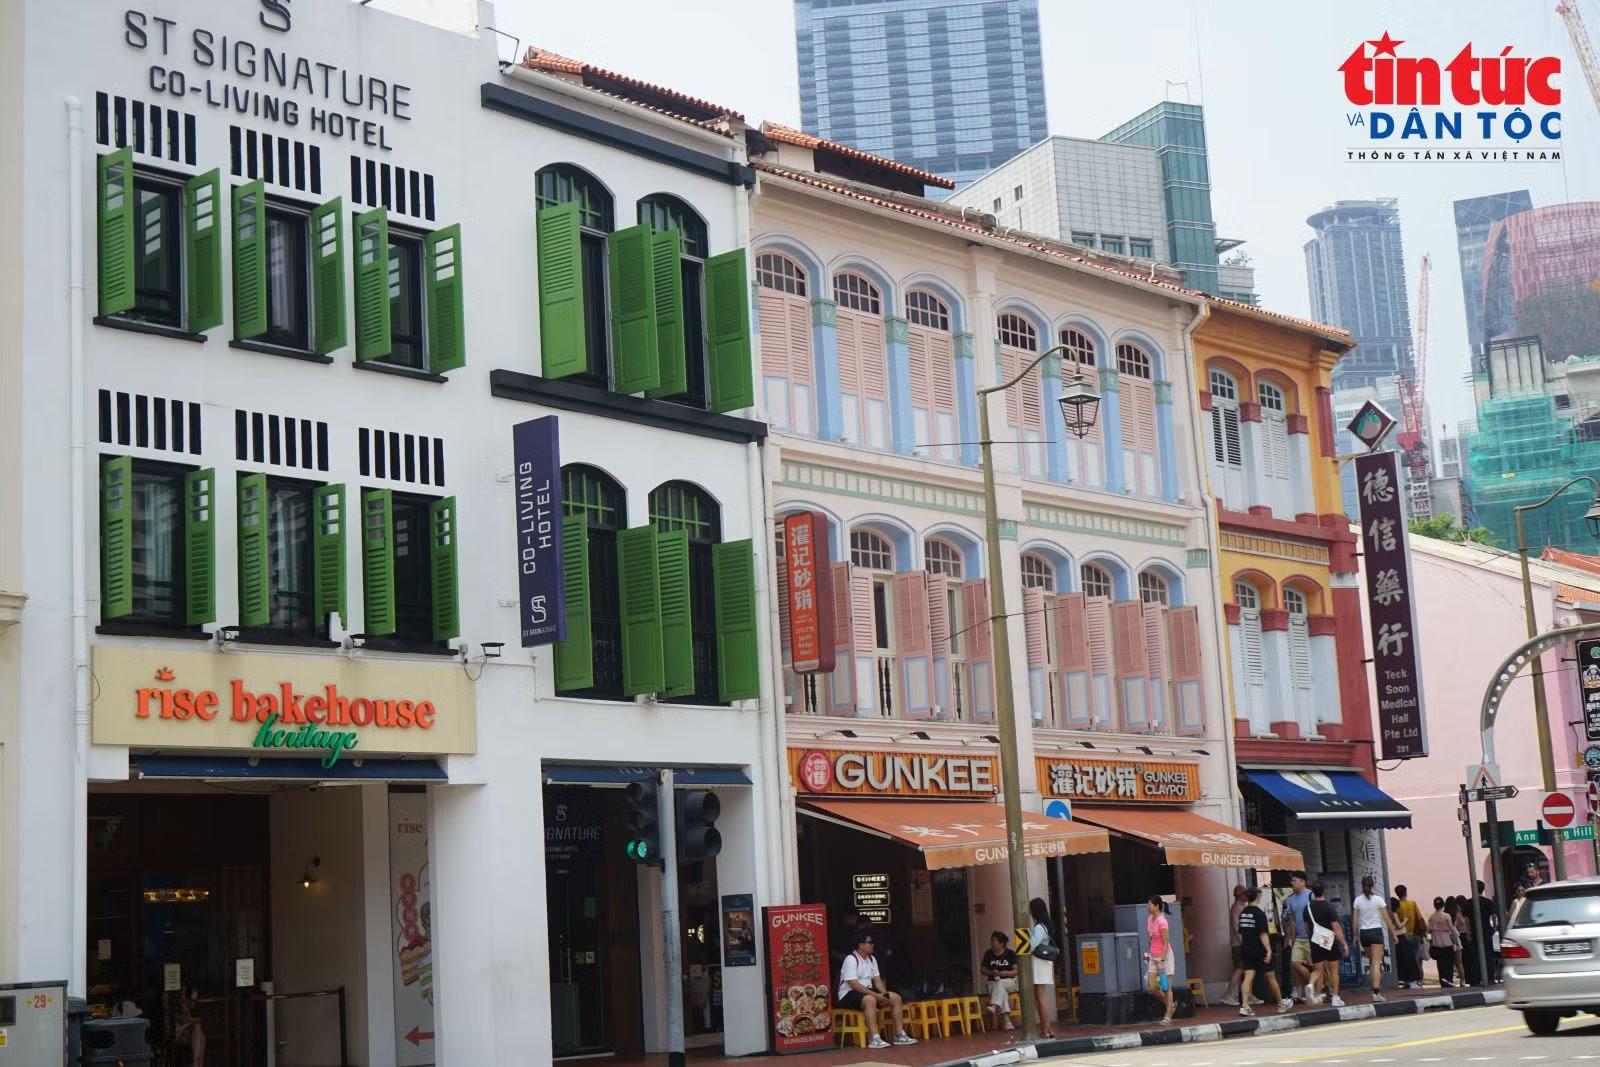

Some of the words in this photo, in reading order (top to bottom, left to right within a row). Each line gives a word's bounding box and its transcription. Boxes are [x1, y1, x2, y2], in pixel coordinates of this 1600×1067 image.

[124, 9, 177, 55] ST
[192, 28, 412, 121] SIGNATURE
[149, 64, 299, 126] CO-LIVING
[311, 106, 392, 151] HOTEL
[519, 461, 536, 574] CO-LIVING
[537, 479, 552, 549] HOTEL
[1384, 669, 1408, 680] Teck
[1385, 684, 1410, 695] Soon
[135, 668, 218, 721] rise
[230, 680, 436, 729] bakehouse
[1381, 697, 1417, 710] Medical
[1391, 713, 1409, 724] Hall
[253, 712, 358, 769] heritage
[1384, 729, 1401, 740] Pte
[1403, 728, 1418, 738] Ltd
[835, 753, 994, 792] GUNKEE
[1050, 763, 1137, 797] 灌记砂锅
[1143, 771, 1187, 783] GUNKEE
[1144, 784, 1188, 796] CLAYPOT
[397, 818, 423, 834] rise
[1573, 826, 1592, 837] Hill
[1515, 832, 1536, 842] Ann
[975, 842, 1031, 862] GUNE
[1201, 851, 1242, 866] GUNKEE
[772, 912, 824, 928] GUNKEE
